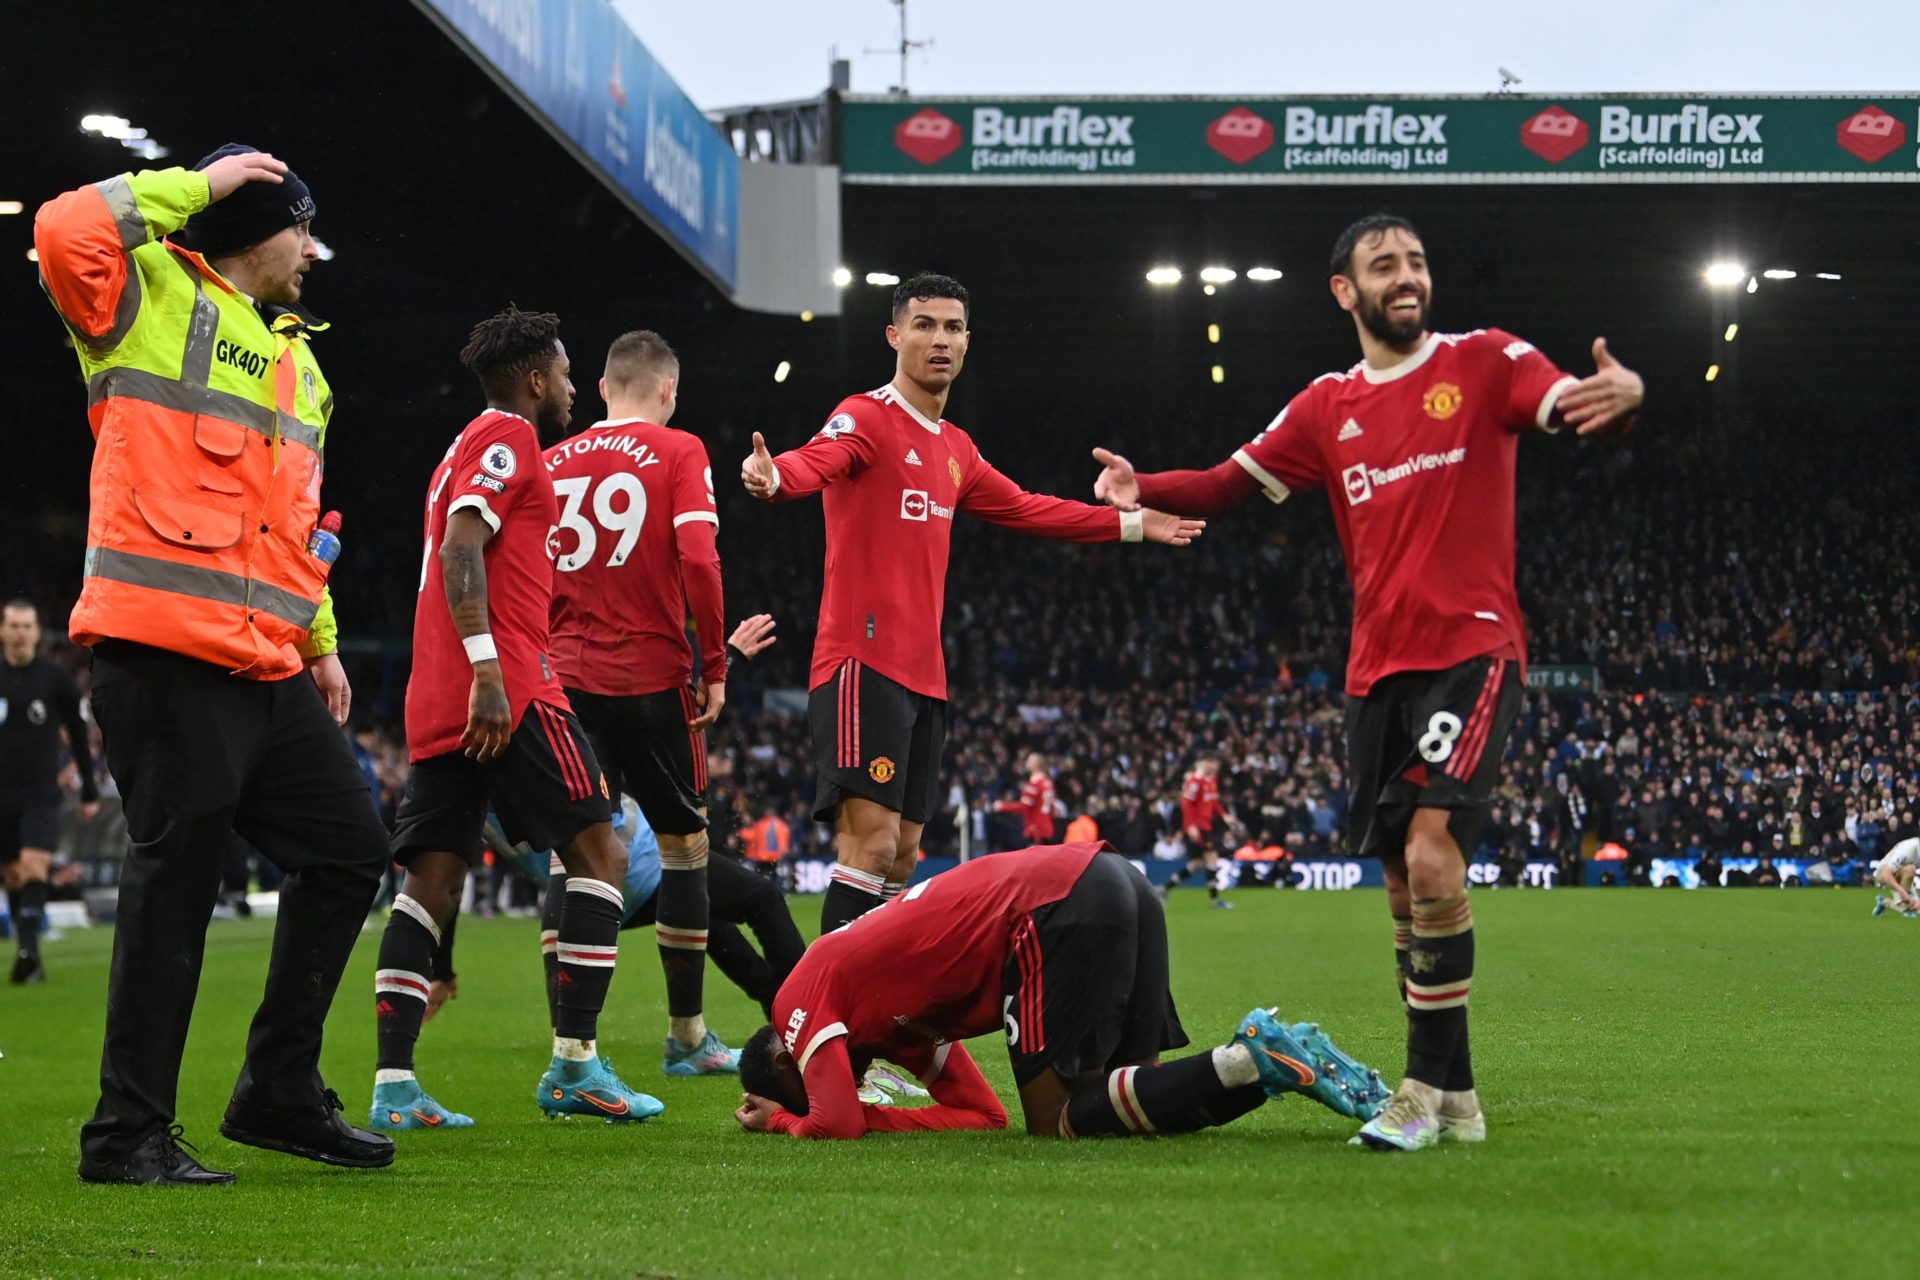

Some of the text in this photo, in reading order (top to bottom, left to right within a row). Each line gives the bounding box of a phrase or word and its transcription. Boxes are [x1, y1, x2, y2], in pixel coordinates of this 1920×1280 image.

[972, 106, 1134, 146] Burflex
[1285, 105, 1447, 145] Burflex
[1599, 105, 1763, 144] Burflex
[972, 149, 1135, 171] (Scaffolding) Ltd
[1284, 148, 1448, 170] (Scaffolding) Ltd
[1599, 147, 1763, 169] (Scaffolding) Ltd
[216, 340, 269, 379] GK407
[1367, 448, 1466, 486] TeamViewer
[552, 472, 647, 572] 39
[1527, 671, 1550, 687] XIT
[1418, 711, 1463, 763] 8
[784, 1008, 808, 1053] HLER
